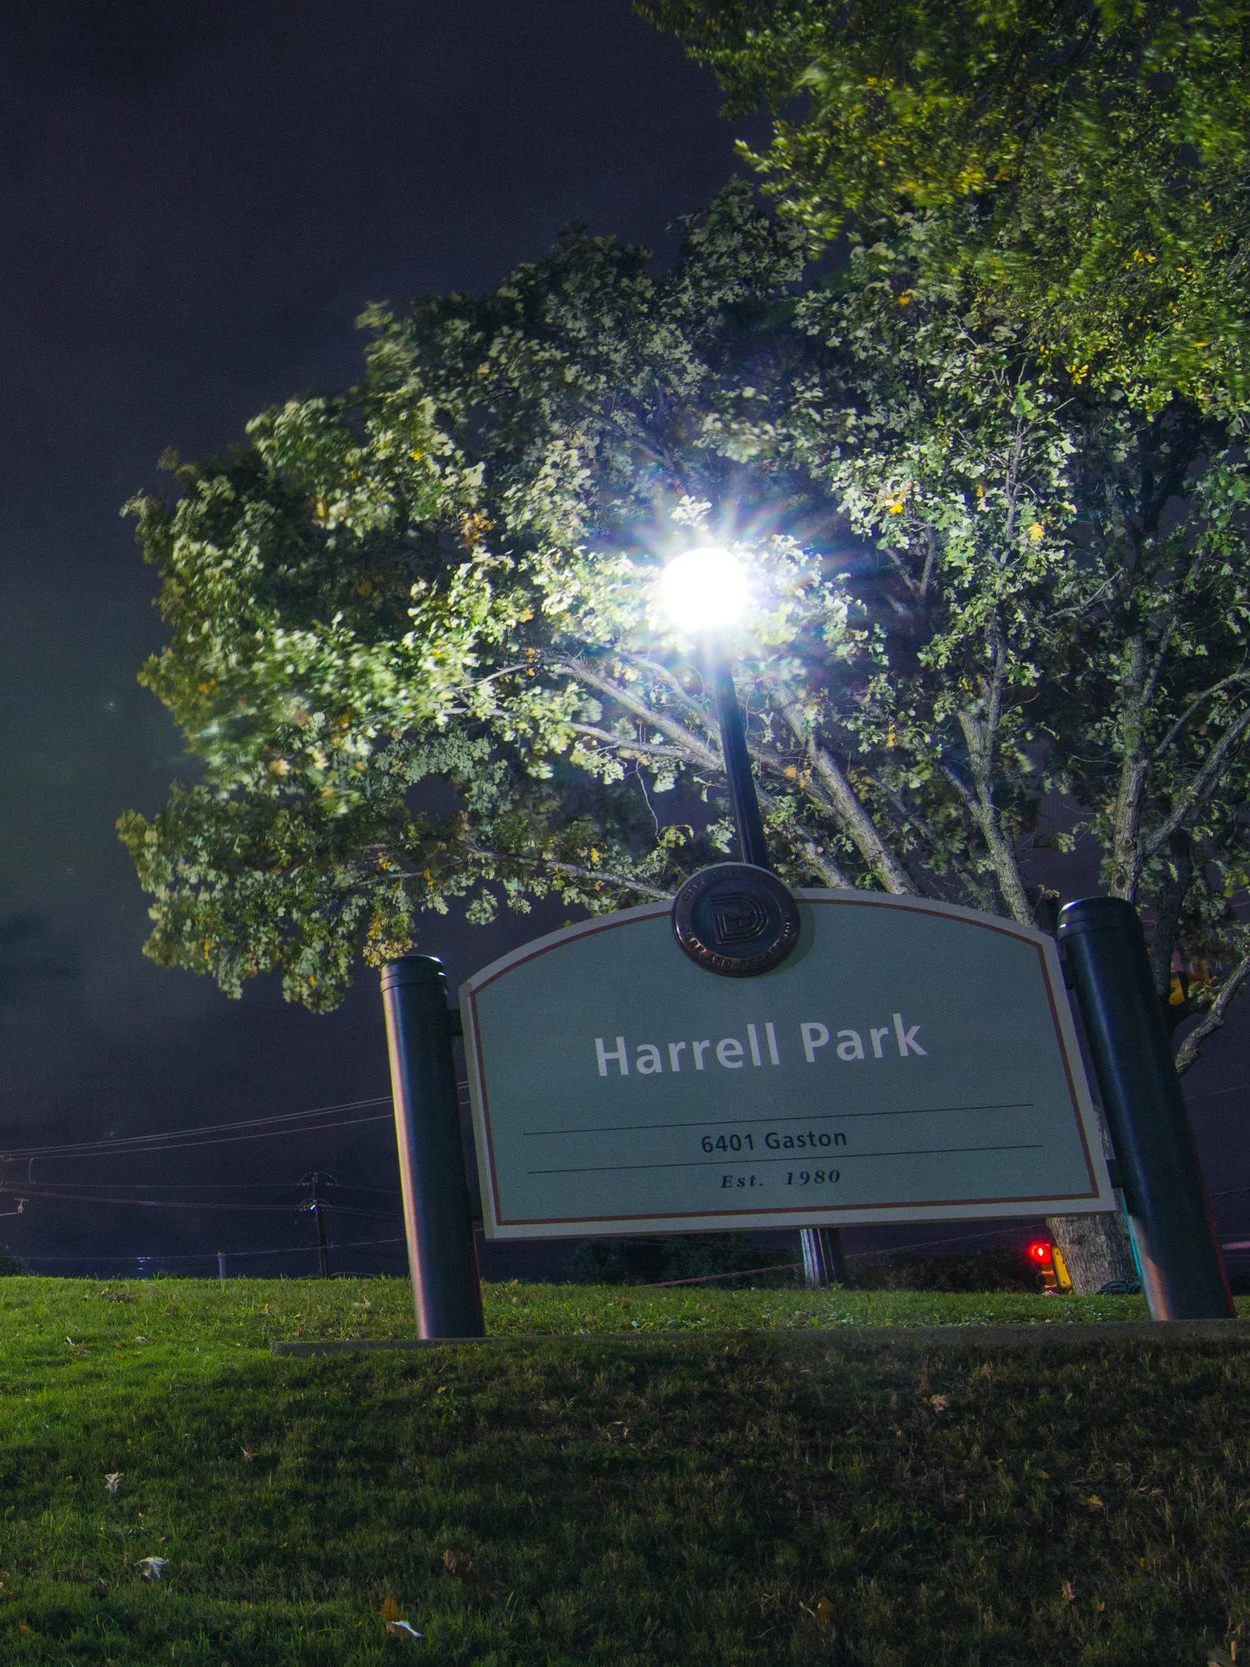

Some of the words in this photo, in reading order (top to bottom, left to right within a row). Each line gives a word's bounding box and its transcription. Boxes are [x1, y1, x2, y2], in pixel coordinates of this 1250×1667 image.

[595, 1022, 780, 1076] Harrell
[800, 1013, 927, 1063] Park
[701, 1133, 755, 1153] 6401
[764, 1130, 848, 1150] Gaston
[720, 1174, 764, 1189] Est.
[785, 1170, 841, 1187] 1980
